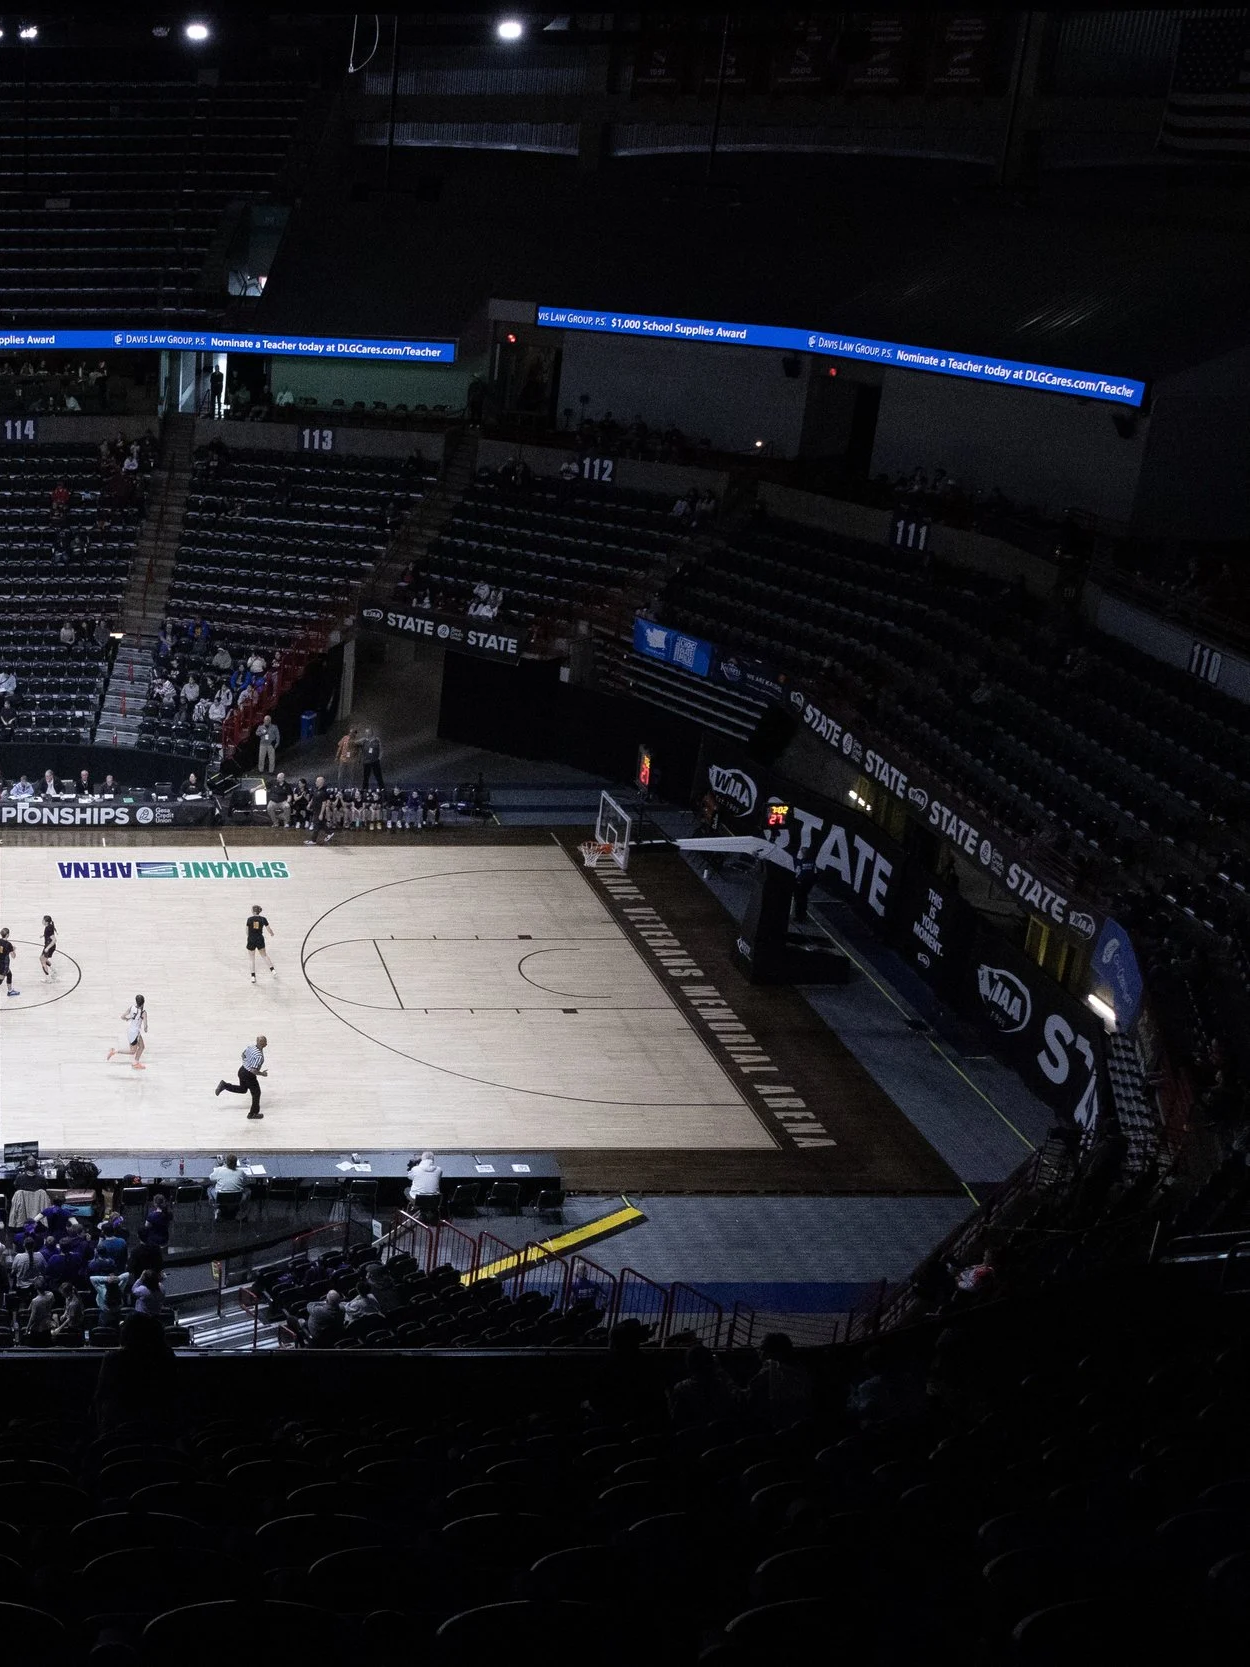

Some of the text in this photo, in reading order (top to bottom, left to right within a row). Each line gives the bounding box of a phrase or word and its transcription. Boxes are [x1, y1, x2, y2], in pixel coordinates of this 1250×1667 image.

[27, 334, 55, 344] Award
[612, 318, 640, 330] $1,000
[643, 320, 673, 332] School
[675, 324, 714, 336] Supplies
[716, 328, 746, 338] Award
[150, 334, 166, 344] LAW
[211, 338, 253, 348] Nominate
[263, 340, 296, 350] Teacher
[299, 342, 324, 354] today
[326, 344, 335, 352] at
[338, 344, 441, 356] DLGCares.com/Teacher
[897, 350, 938, 366] Nominate
[940, 358, 946, 368] a
[948, 358, 983, 372] Teacher
[985, 364, 1011, 380] today
[1013, 370, 1023, 380] at
[1025, 370, 1134, 398] DLGCares.com/Teacher
[5, 420, 35, 440] 114
[303, 429, 332, 450] 113
[583, 457, 613, 482] 112
[896, 520, 927, 550] 111
[387, 612, 434, 636] STATE
[467, 630, 518, 653] STATE
[1190, 643, 1222, 684] 110
[768, 814, 784, 825] 27
[771, 806, 790, 814] 7:02
[804, 704, 842, 748] STATE
[865, 750, 909, 799] STATE
[929, 801, 979, 855] STATE
[1006, 863, 1067, 924] STATE
[58, 862, 289, 878] SPOKANE ARENA
[928, 888, 943, 910] THIS
[929, 905, 937, 920] IS
[922, 912, 941, 938] YOUR
[622, 907, 704, 977] VETERANS
[680, 986, 779, 1074] MEMORIAL
[752, 1084, 837, 1148] ARENA
